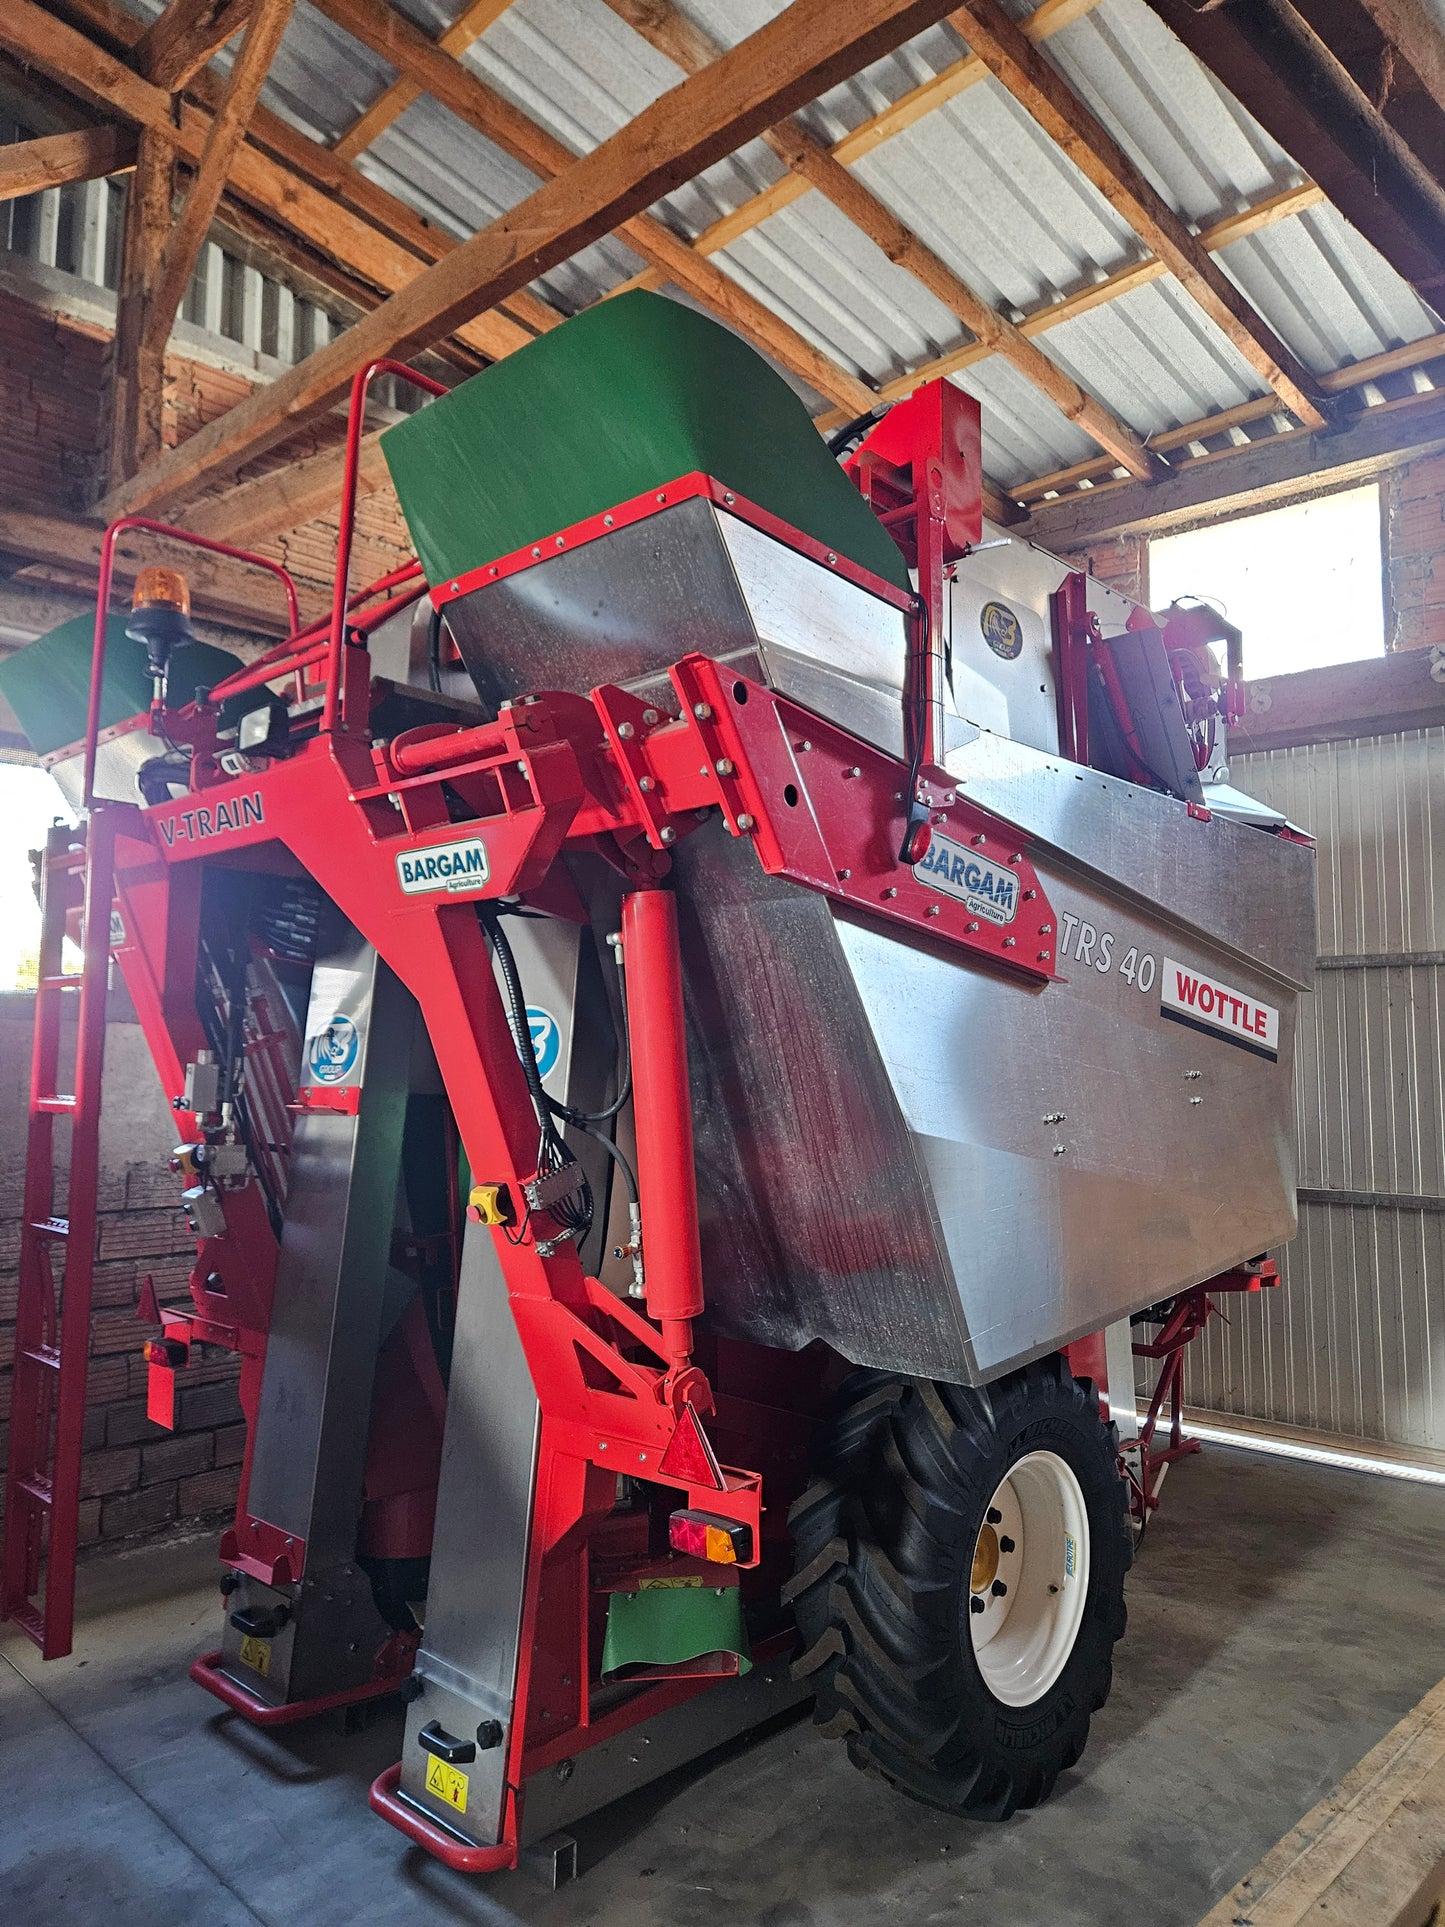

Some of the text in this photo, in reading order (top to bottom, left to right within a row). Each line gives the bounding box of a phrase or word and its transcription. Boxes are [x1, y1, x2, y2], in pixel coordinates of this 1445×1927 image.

[158, 791, 265, 848] V-TRAIN
[401, 848, 484, 883] BARGAM
[449, 878, 481, 890] Agriculture
[968, 899, 1004, 923] Agriculture
[1060, 911, 1156, 993] TRS 40
[1176, 970, 1267, 1039] WOTTLE
